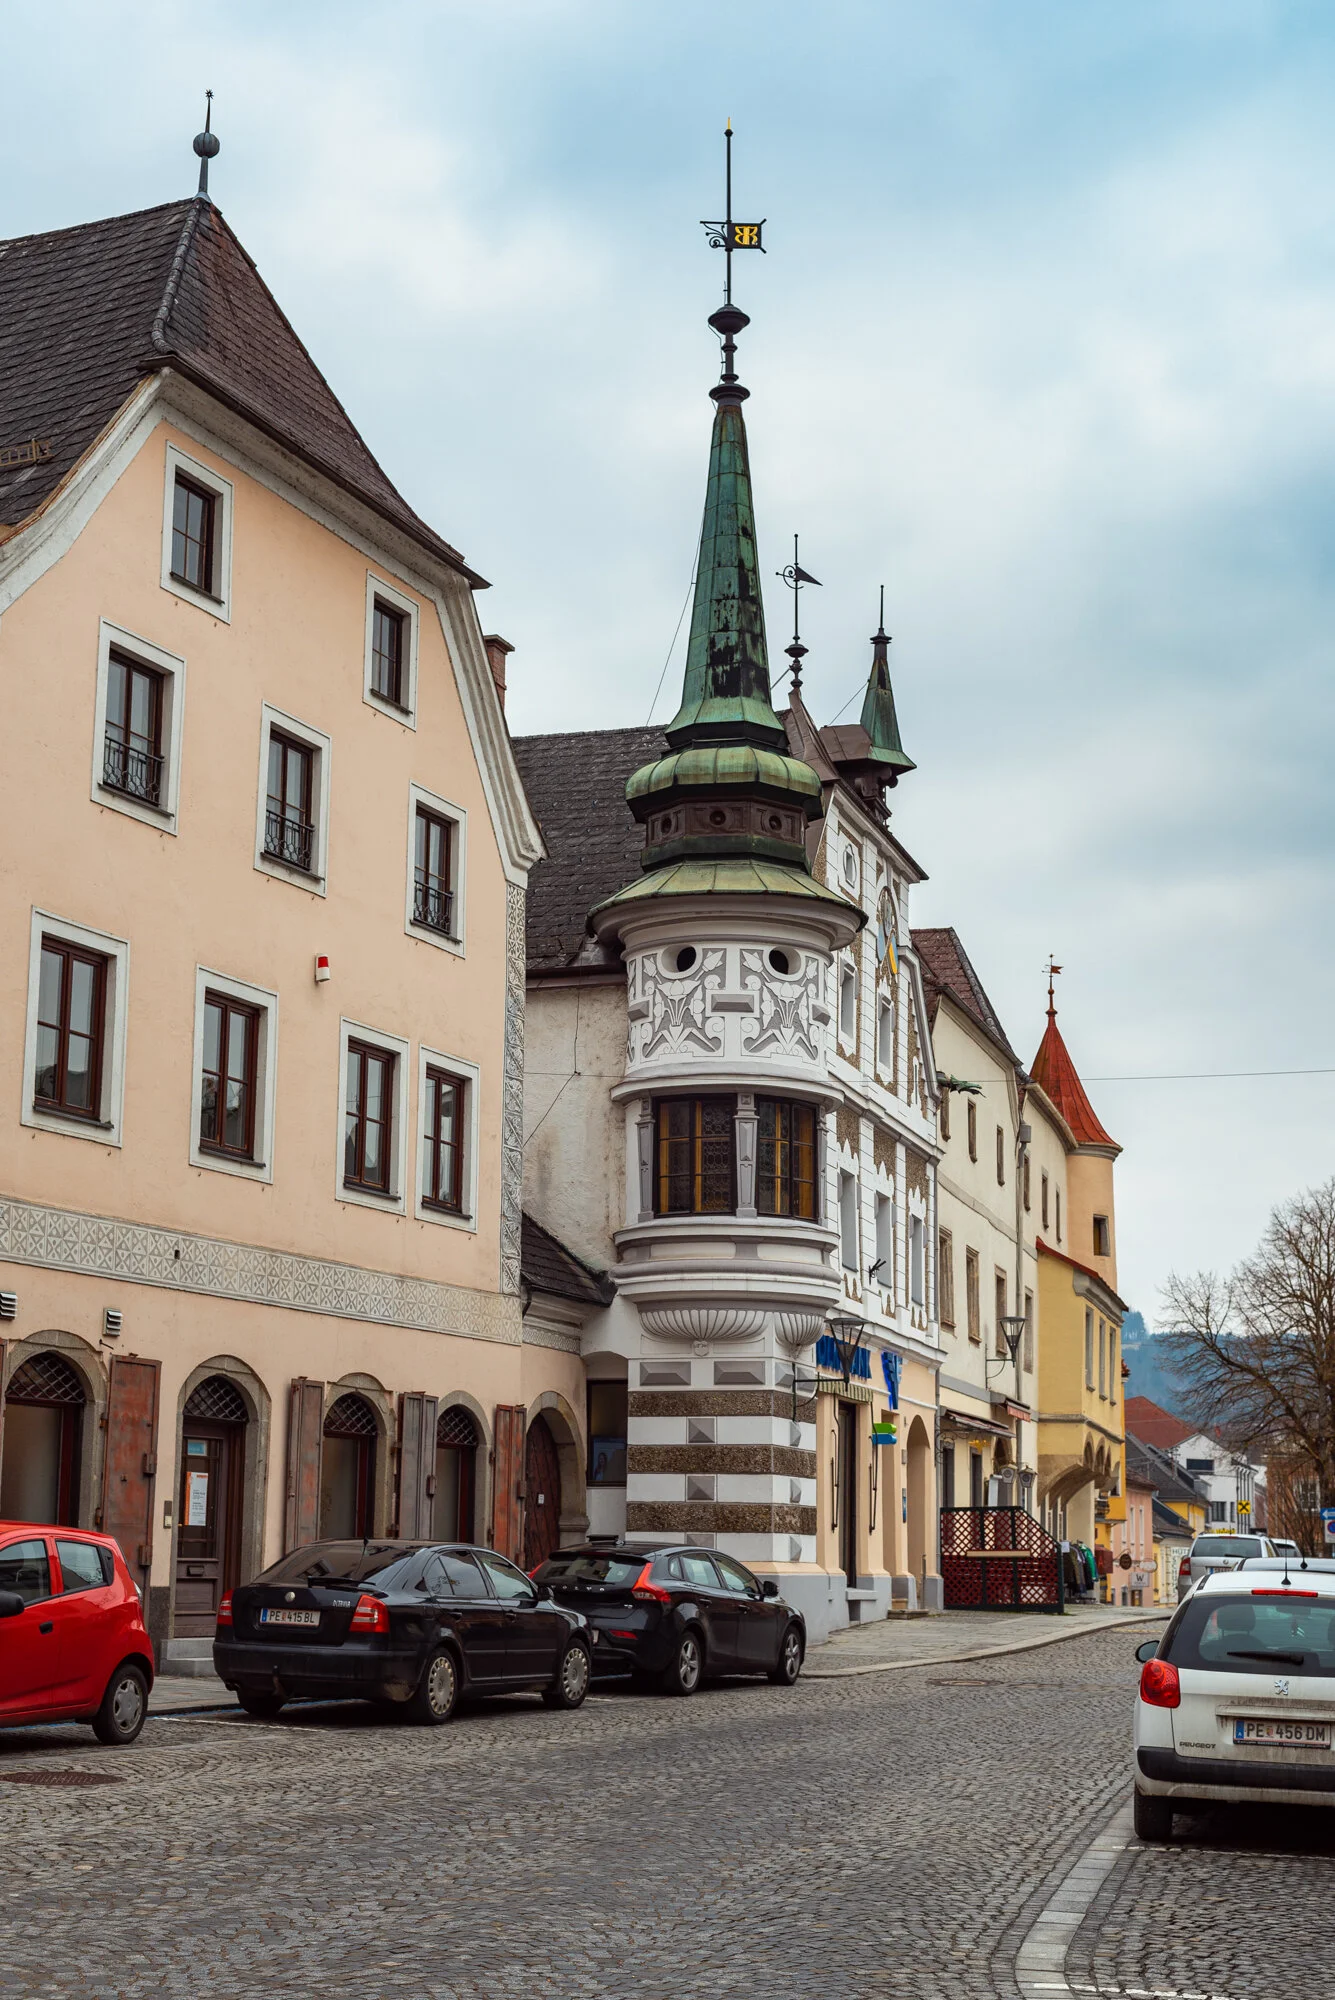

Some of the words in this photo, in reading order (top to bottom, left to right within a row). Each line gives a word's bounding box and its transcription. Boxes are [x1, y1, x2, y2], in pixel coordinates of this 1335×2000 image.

[269, 1610, 282, 1621] PE
[287, 1612, 302, 1622] 415
[304, 1612, 315, 1623] BL
[1246, 1723, 1265, 1738] PE
[1275, 1725, 1303, 1740] 456
[1306, 1726, 1326, 1741] DM
[1179, 1741, 1217, 1749] PEUGEOT
